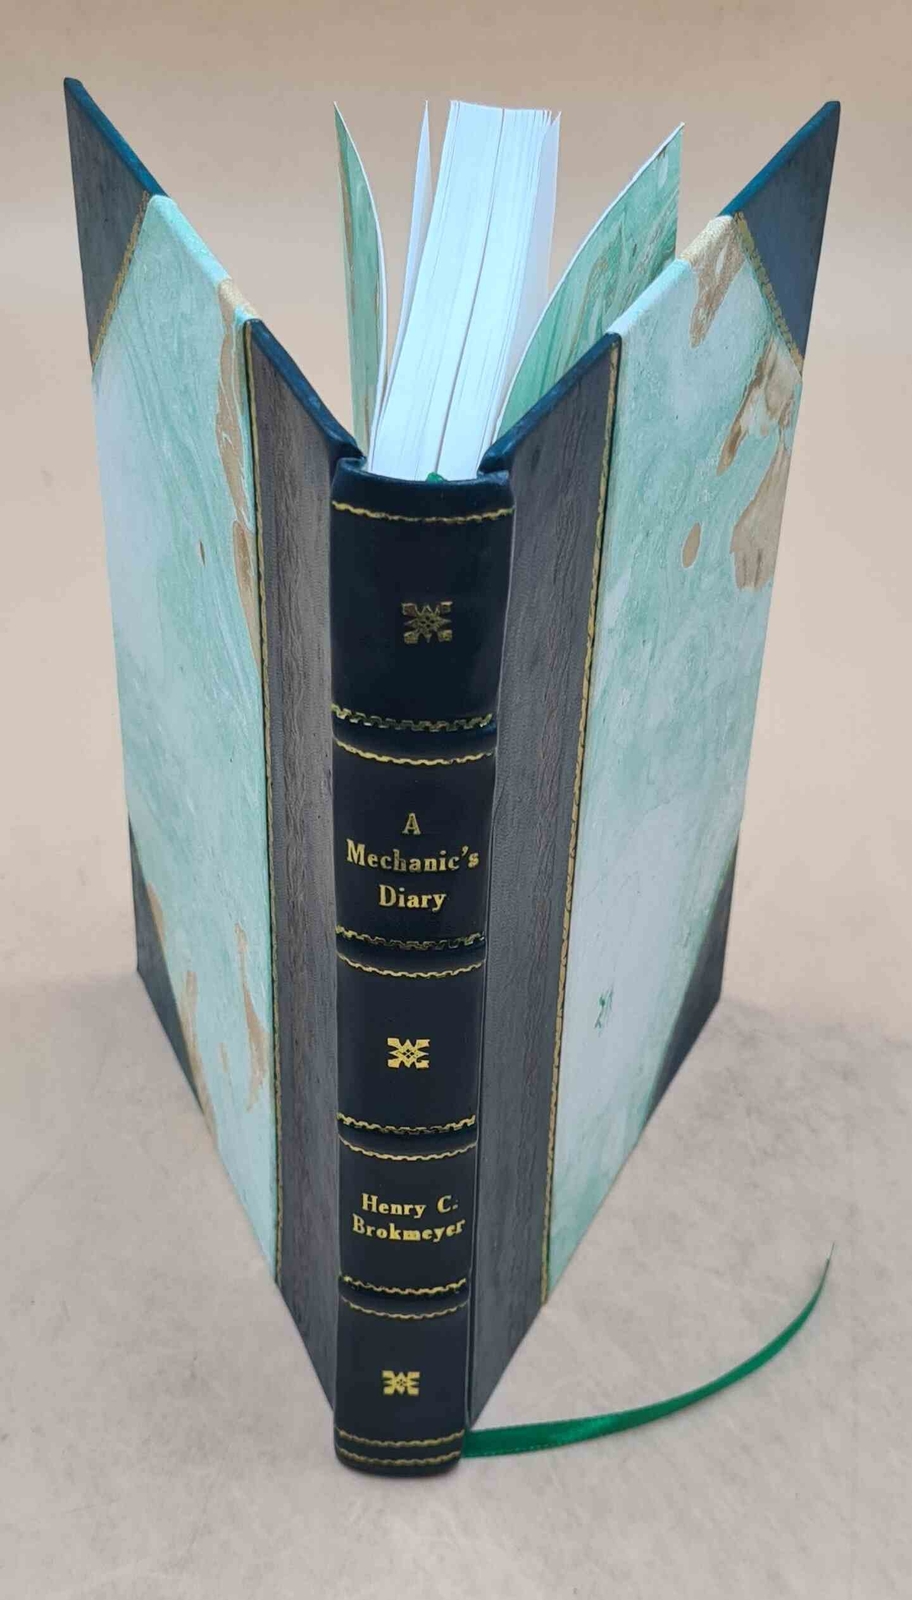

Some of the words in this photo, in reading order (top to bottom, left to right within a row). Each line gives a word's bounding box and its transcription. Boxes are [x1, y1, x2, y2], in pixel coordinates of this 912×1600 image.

[402, 812, 421, 835] A
[346, 838, 479, 872] Mechanic's
[378, 884, 447, 912] Diary
[361, 1192, 427, 1219] Henry
[352, 1213, 466, 1243] Brokmeyer
